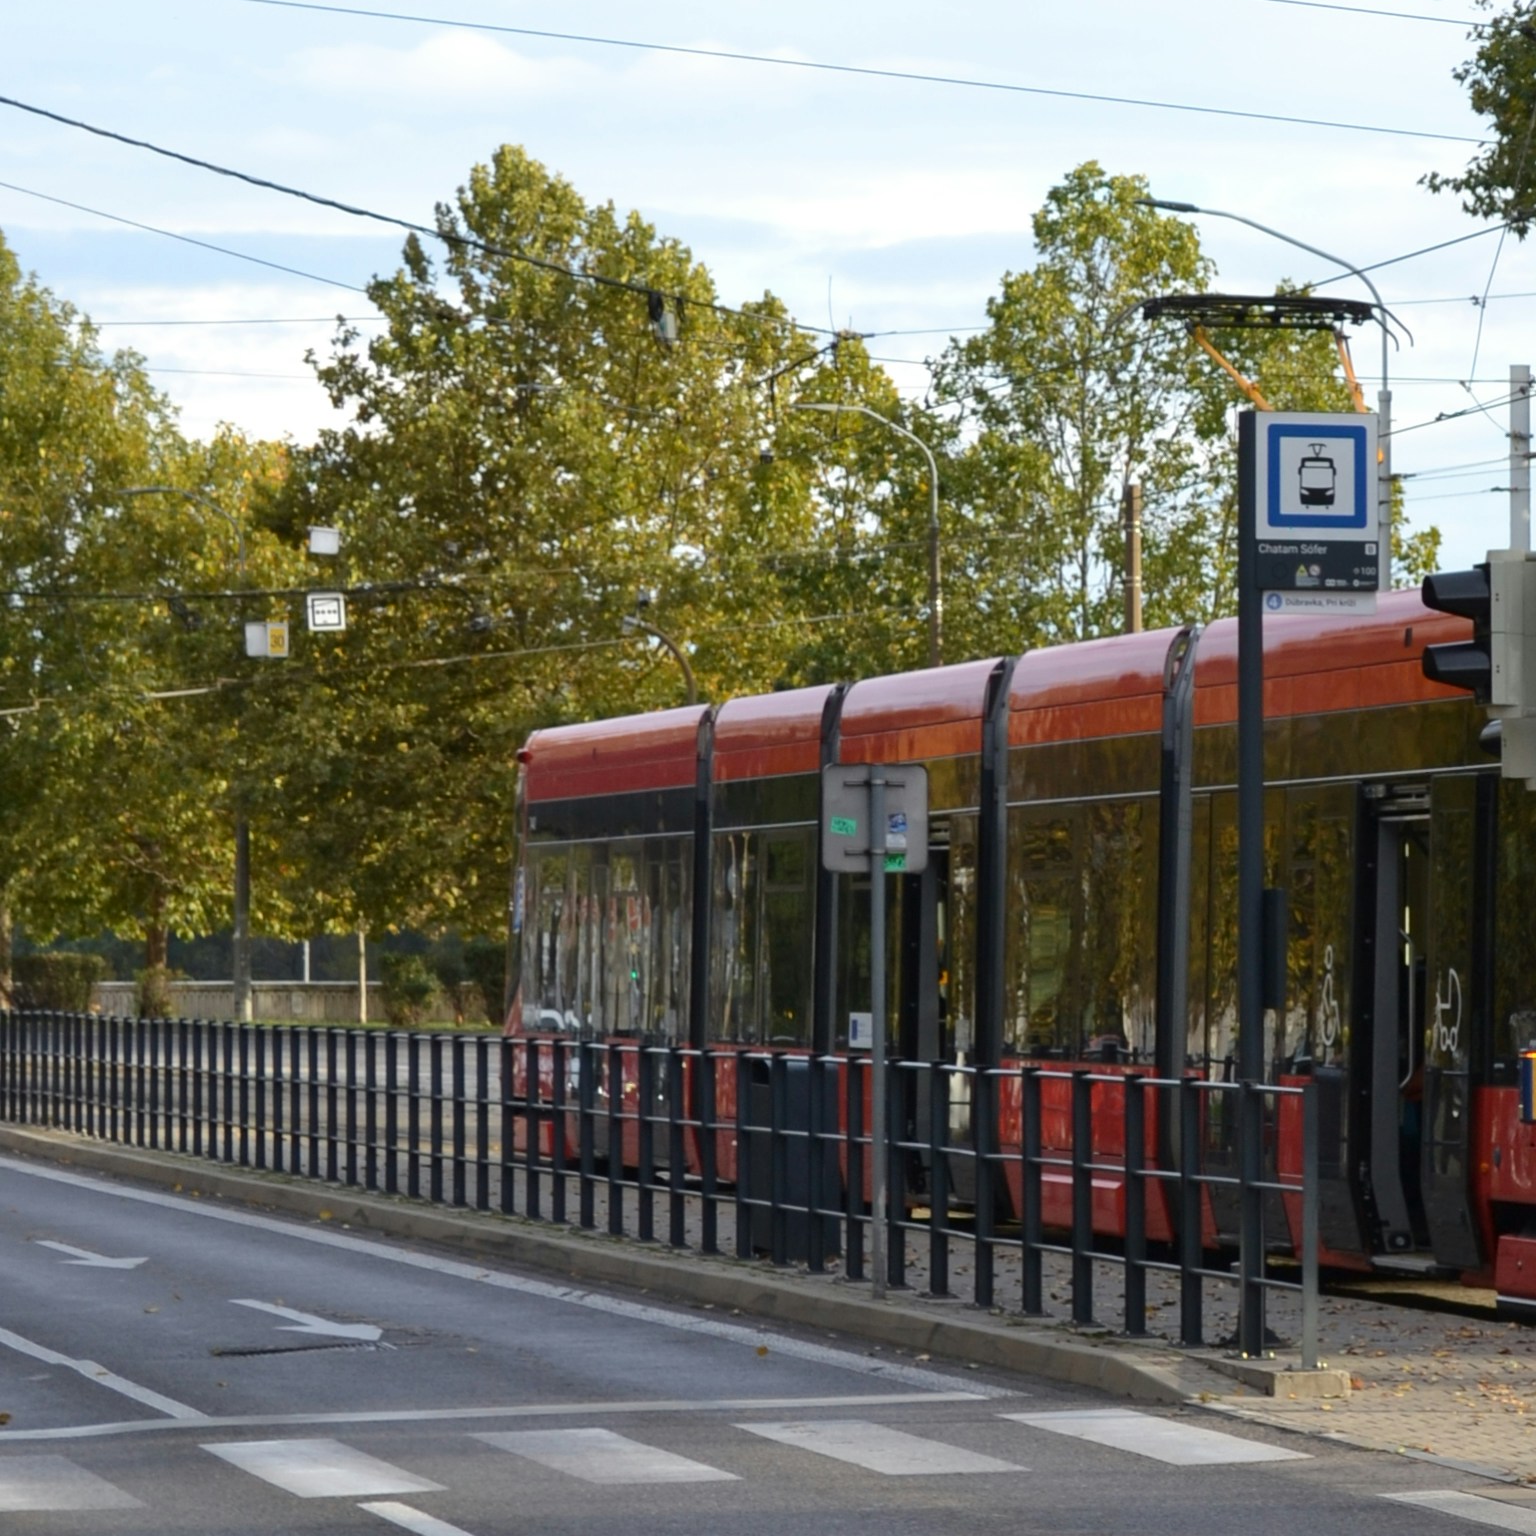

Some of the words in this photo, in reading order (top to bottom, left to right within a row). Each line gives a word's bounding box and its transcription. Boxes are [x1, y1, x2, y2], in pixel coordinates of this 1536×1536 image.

[1258, 543, 1298, 554] Chatam
[1300, 543, 1328, 554] Sófer
[1360, 566, 1377, 576] 100
